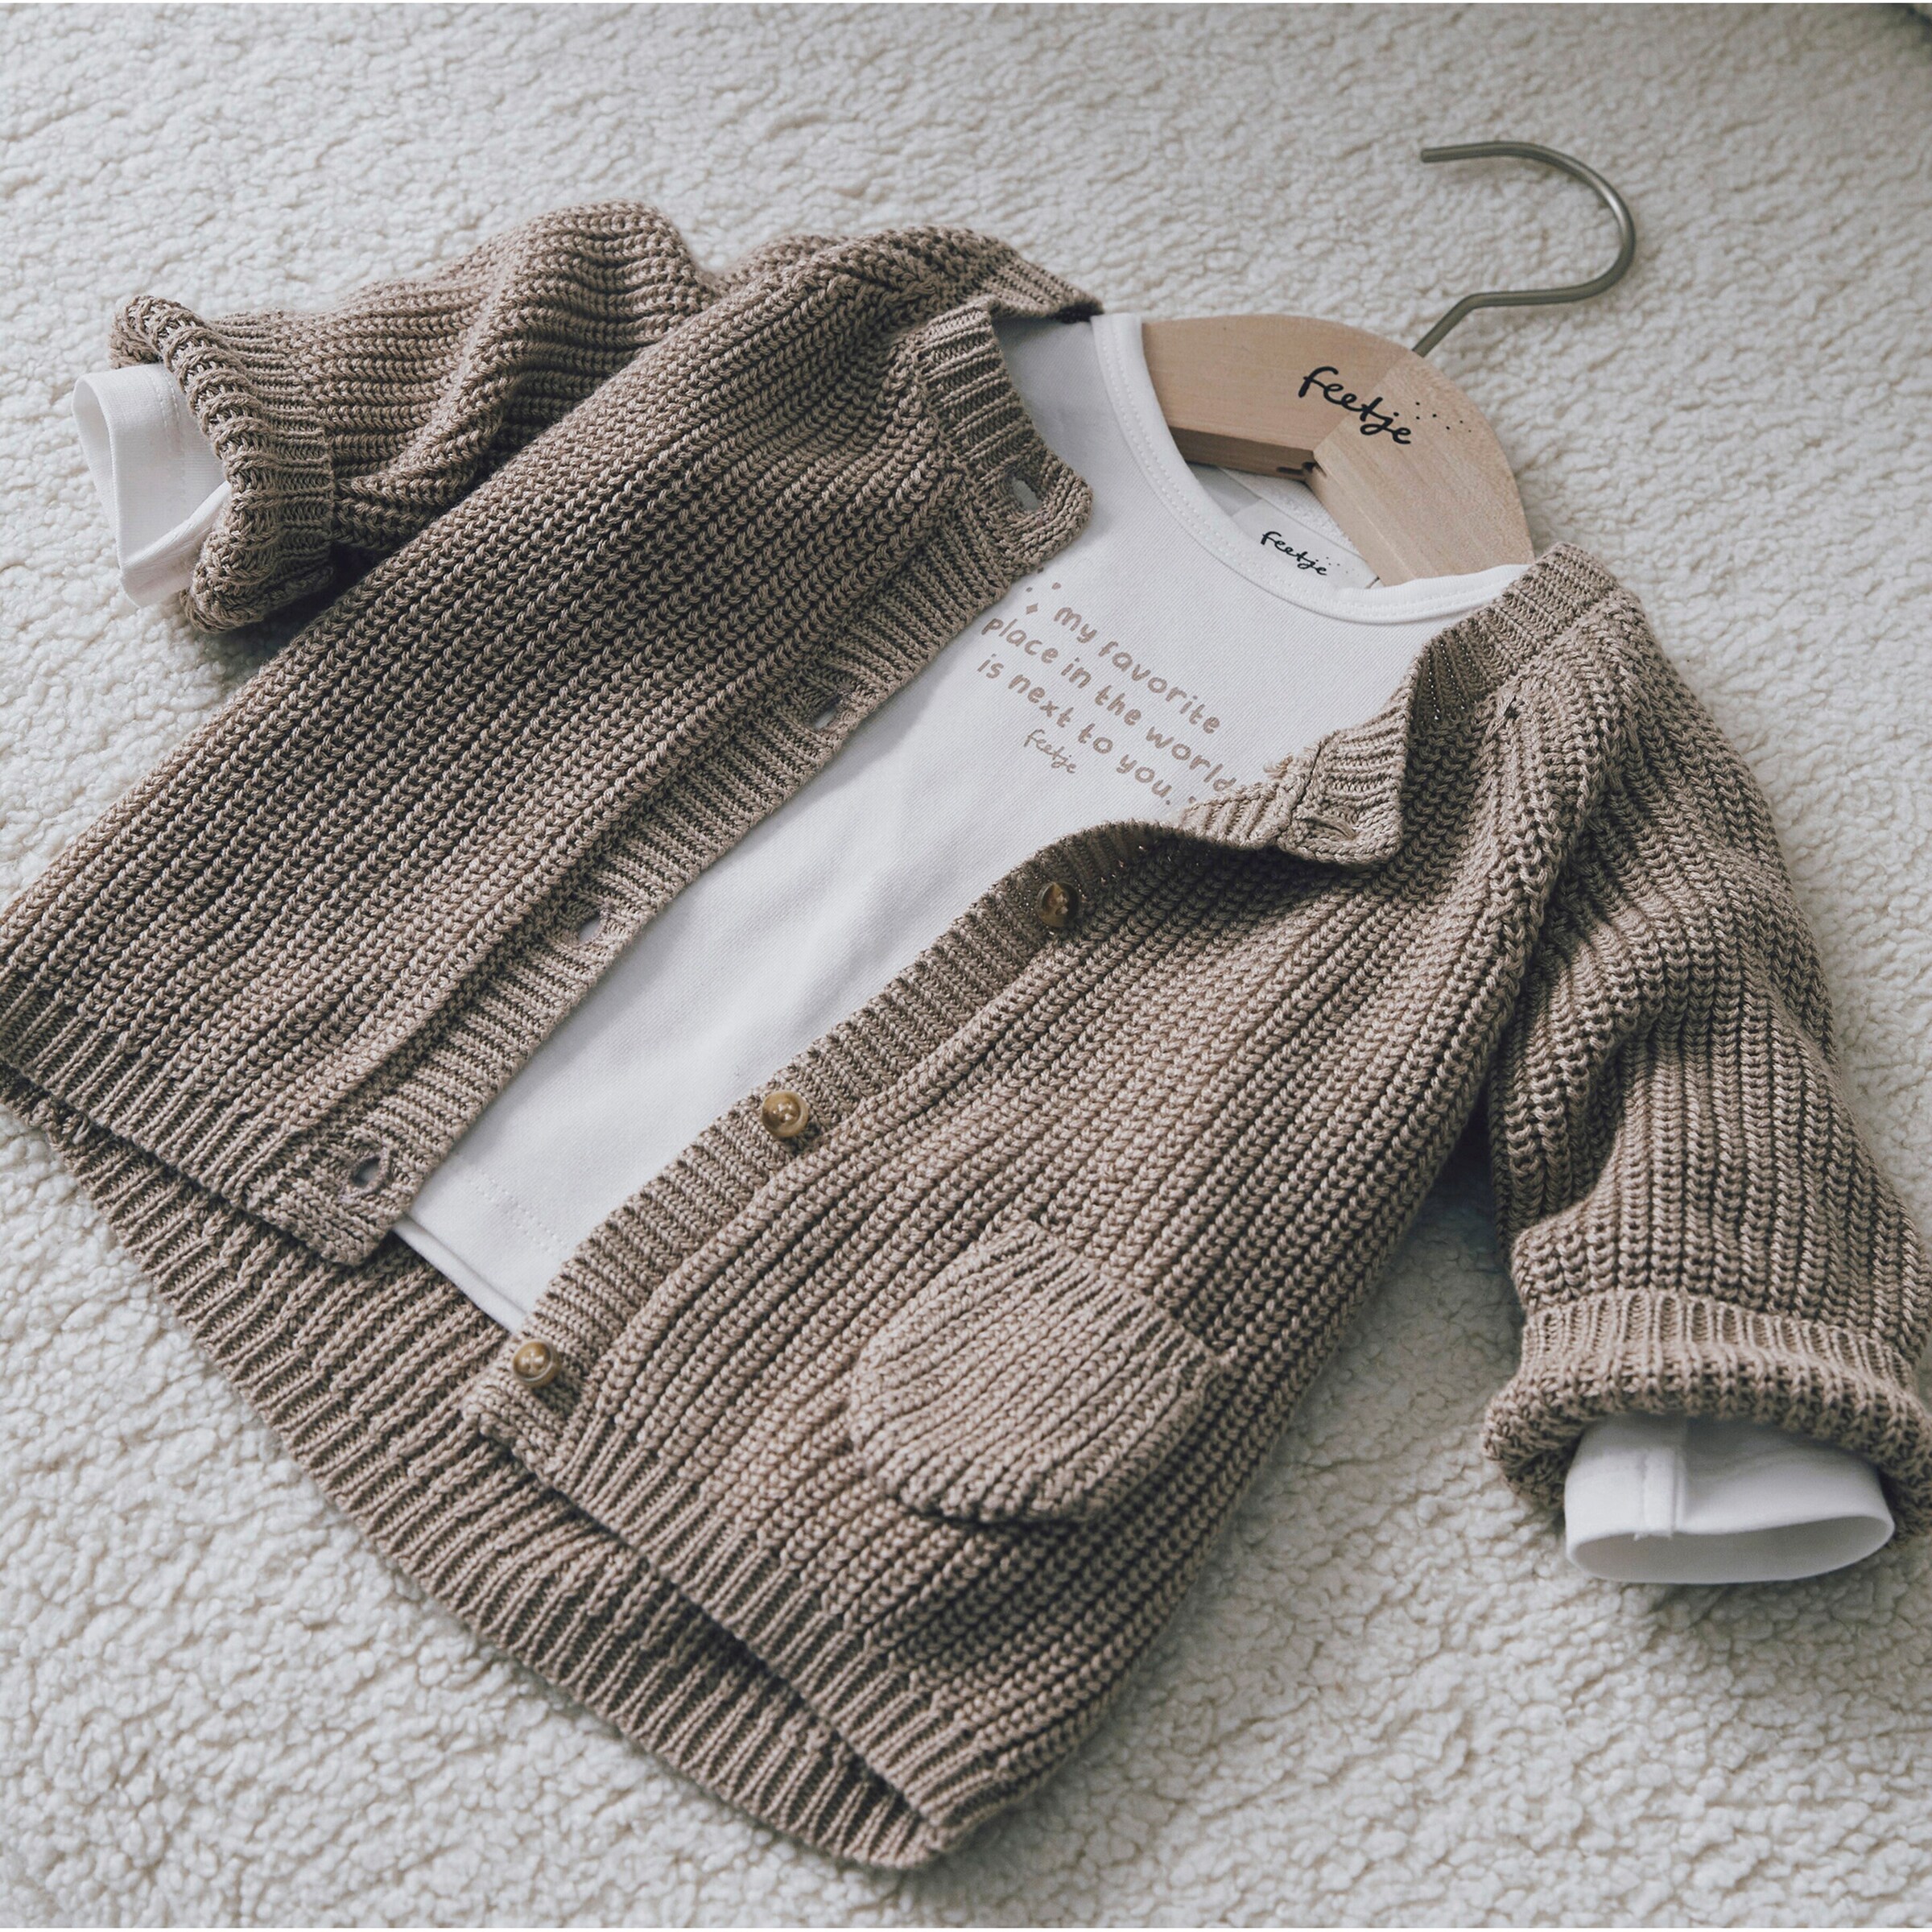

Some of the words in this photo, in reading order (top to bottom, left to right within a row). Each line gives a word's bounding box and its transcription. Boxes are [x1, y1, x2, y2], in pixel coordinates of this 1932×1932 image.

[976, 654, 1004, 679] is
[1008, 674, 1074, 728] next
[1078, 723, 1113, 754] to
[980, 618, 1059, 664] place
[1061, 657, 1092, 689] in
[1094, 684, 1141, 726] the
[1146, 726, 1237, 792] world
[1053, 606, 1097, 643] my
[1098, 641, 1220, 734] favorite
